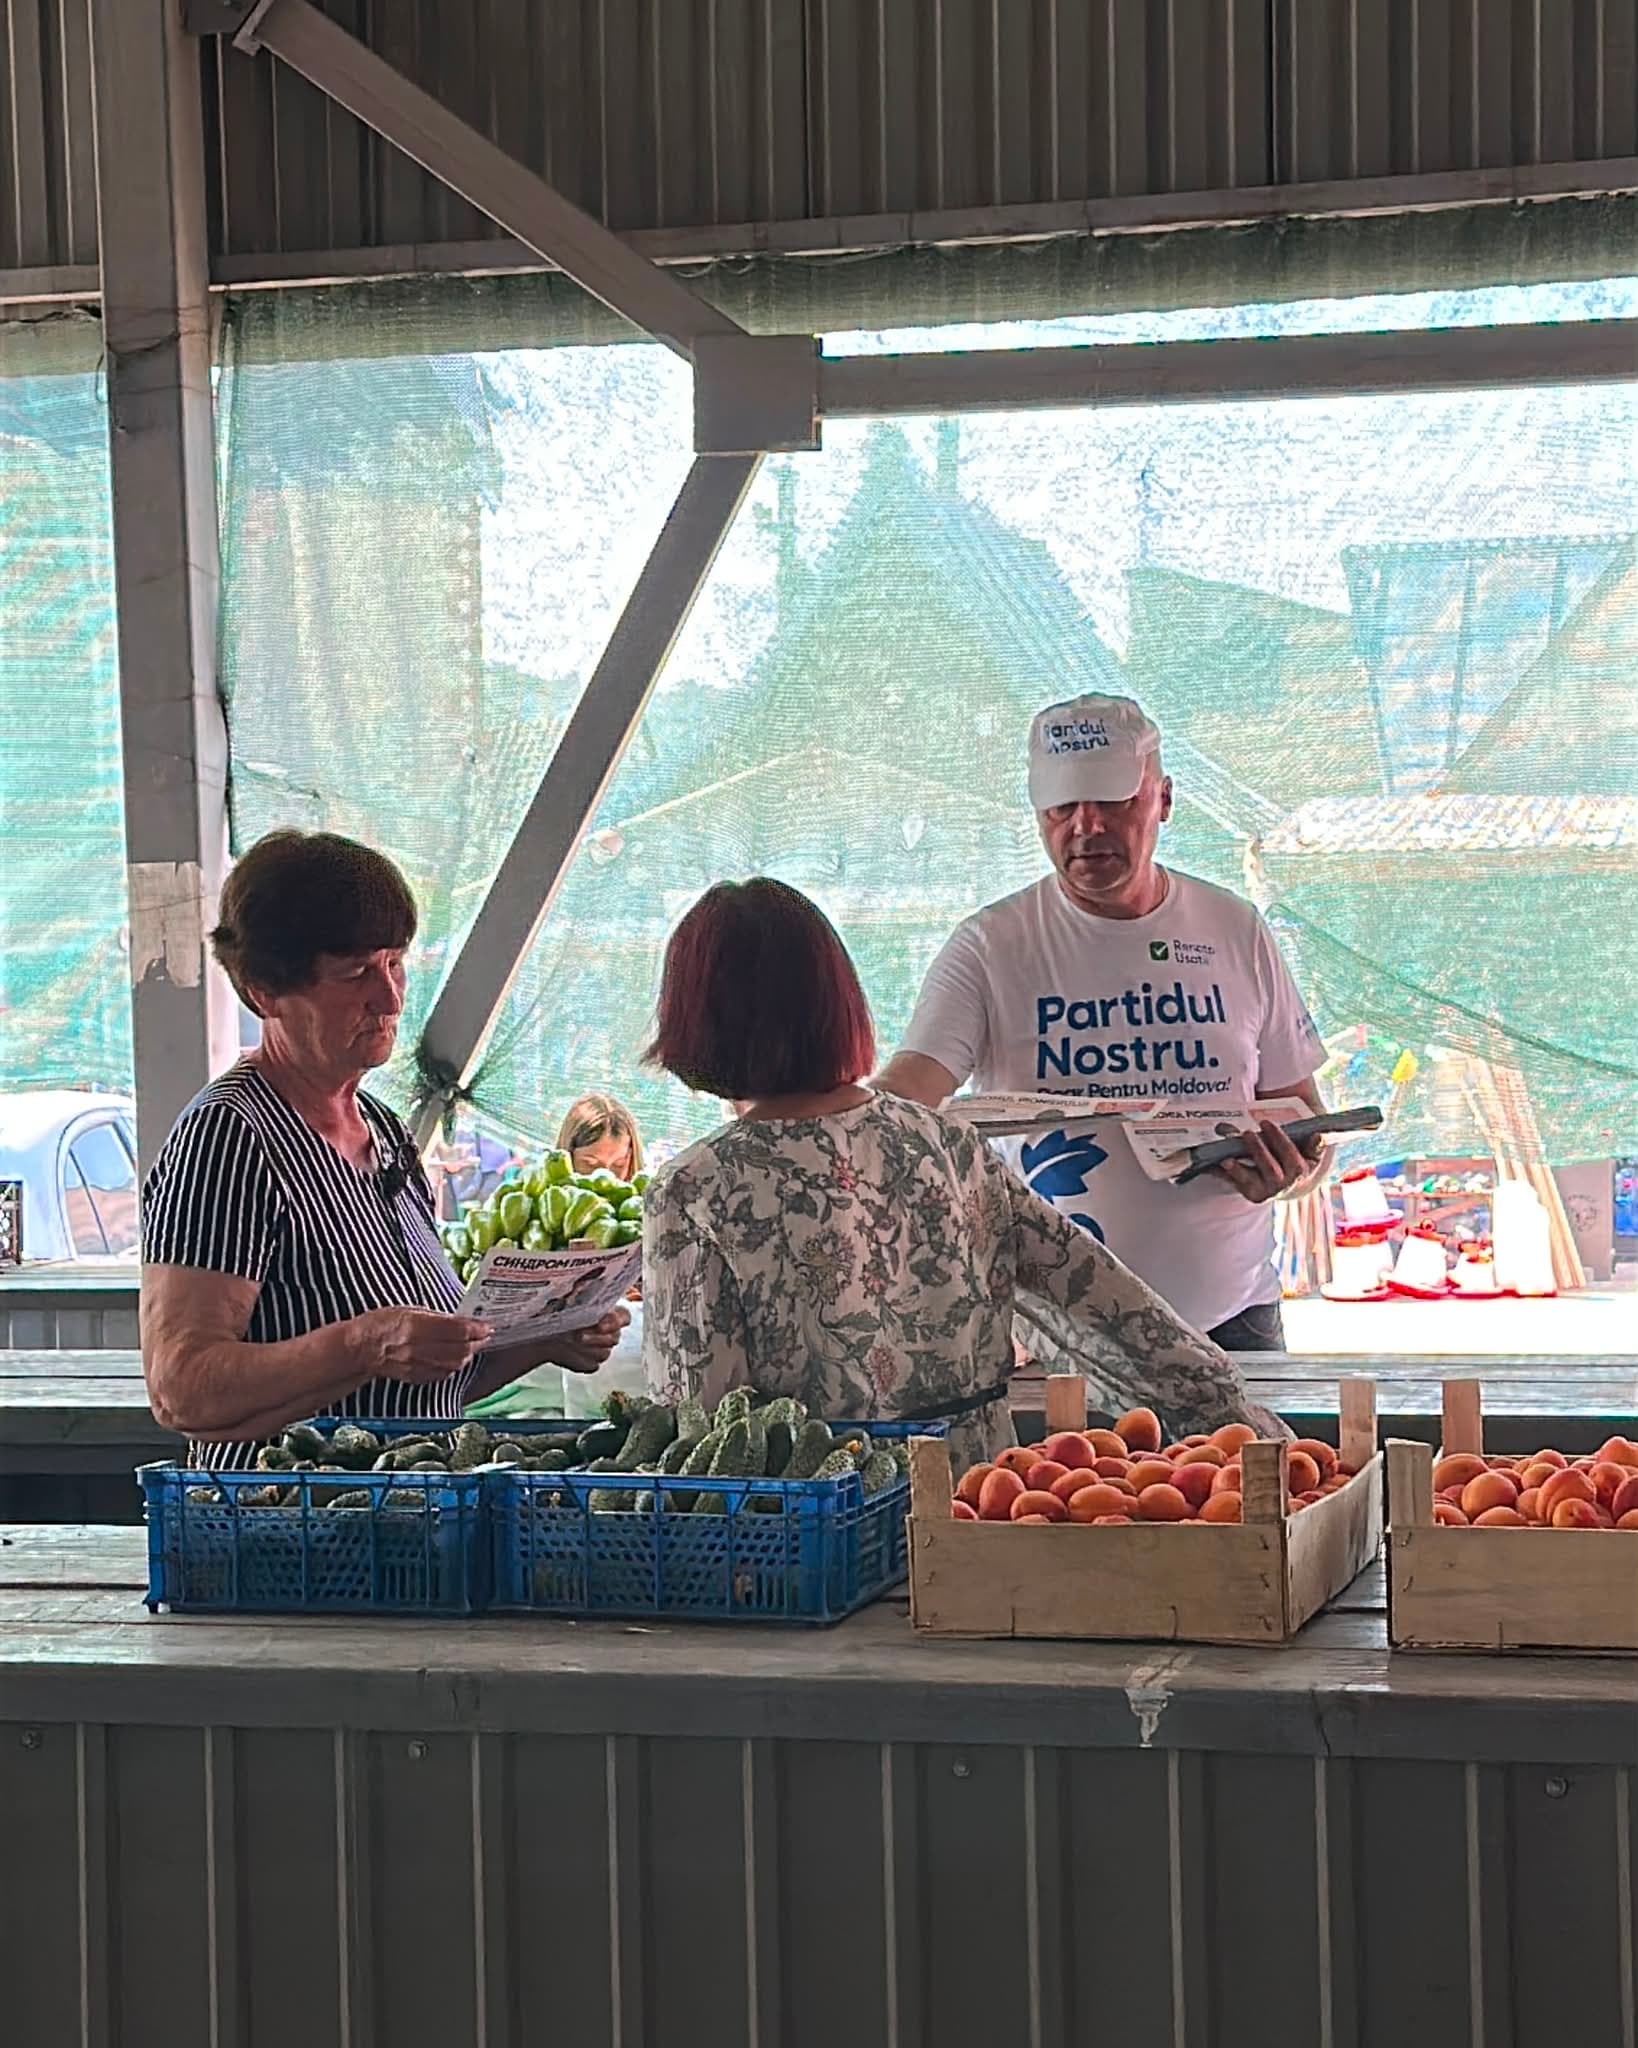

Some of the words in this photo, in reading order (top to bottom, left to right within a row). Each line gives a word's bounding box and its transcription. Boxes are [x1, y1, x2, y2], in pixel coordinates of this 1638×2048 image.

[1037, 981, 1226, 1035] Partidul
[1036, 1036, 1219, 1079] Nostru.
[1088, 1081, 1148, 1098] Pentru
[1151, 1076, 1232, 1096] Moldova!
[493, 1255, 570, 1271] СИНДРОМ
